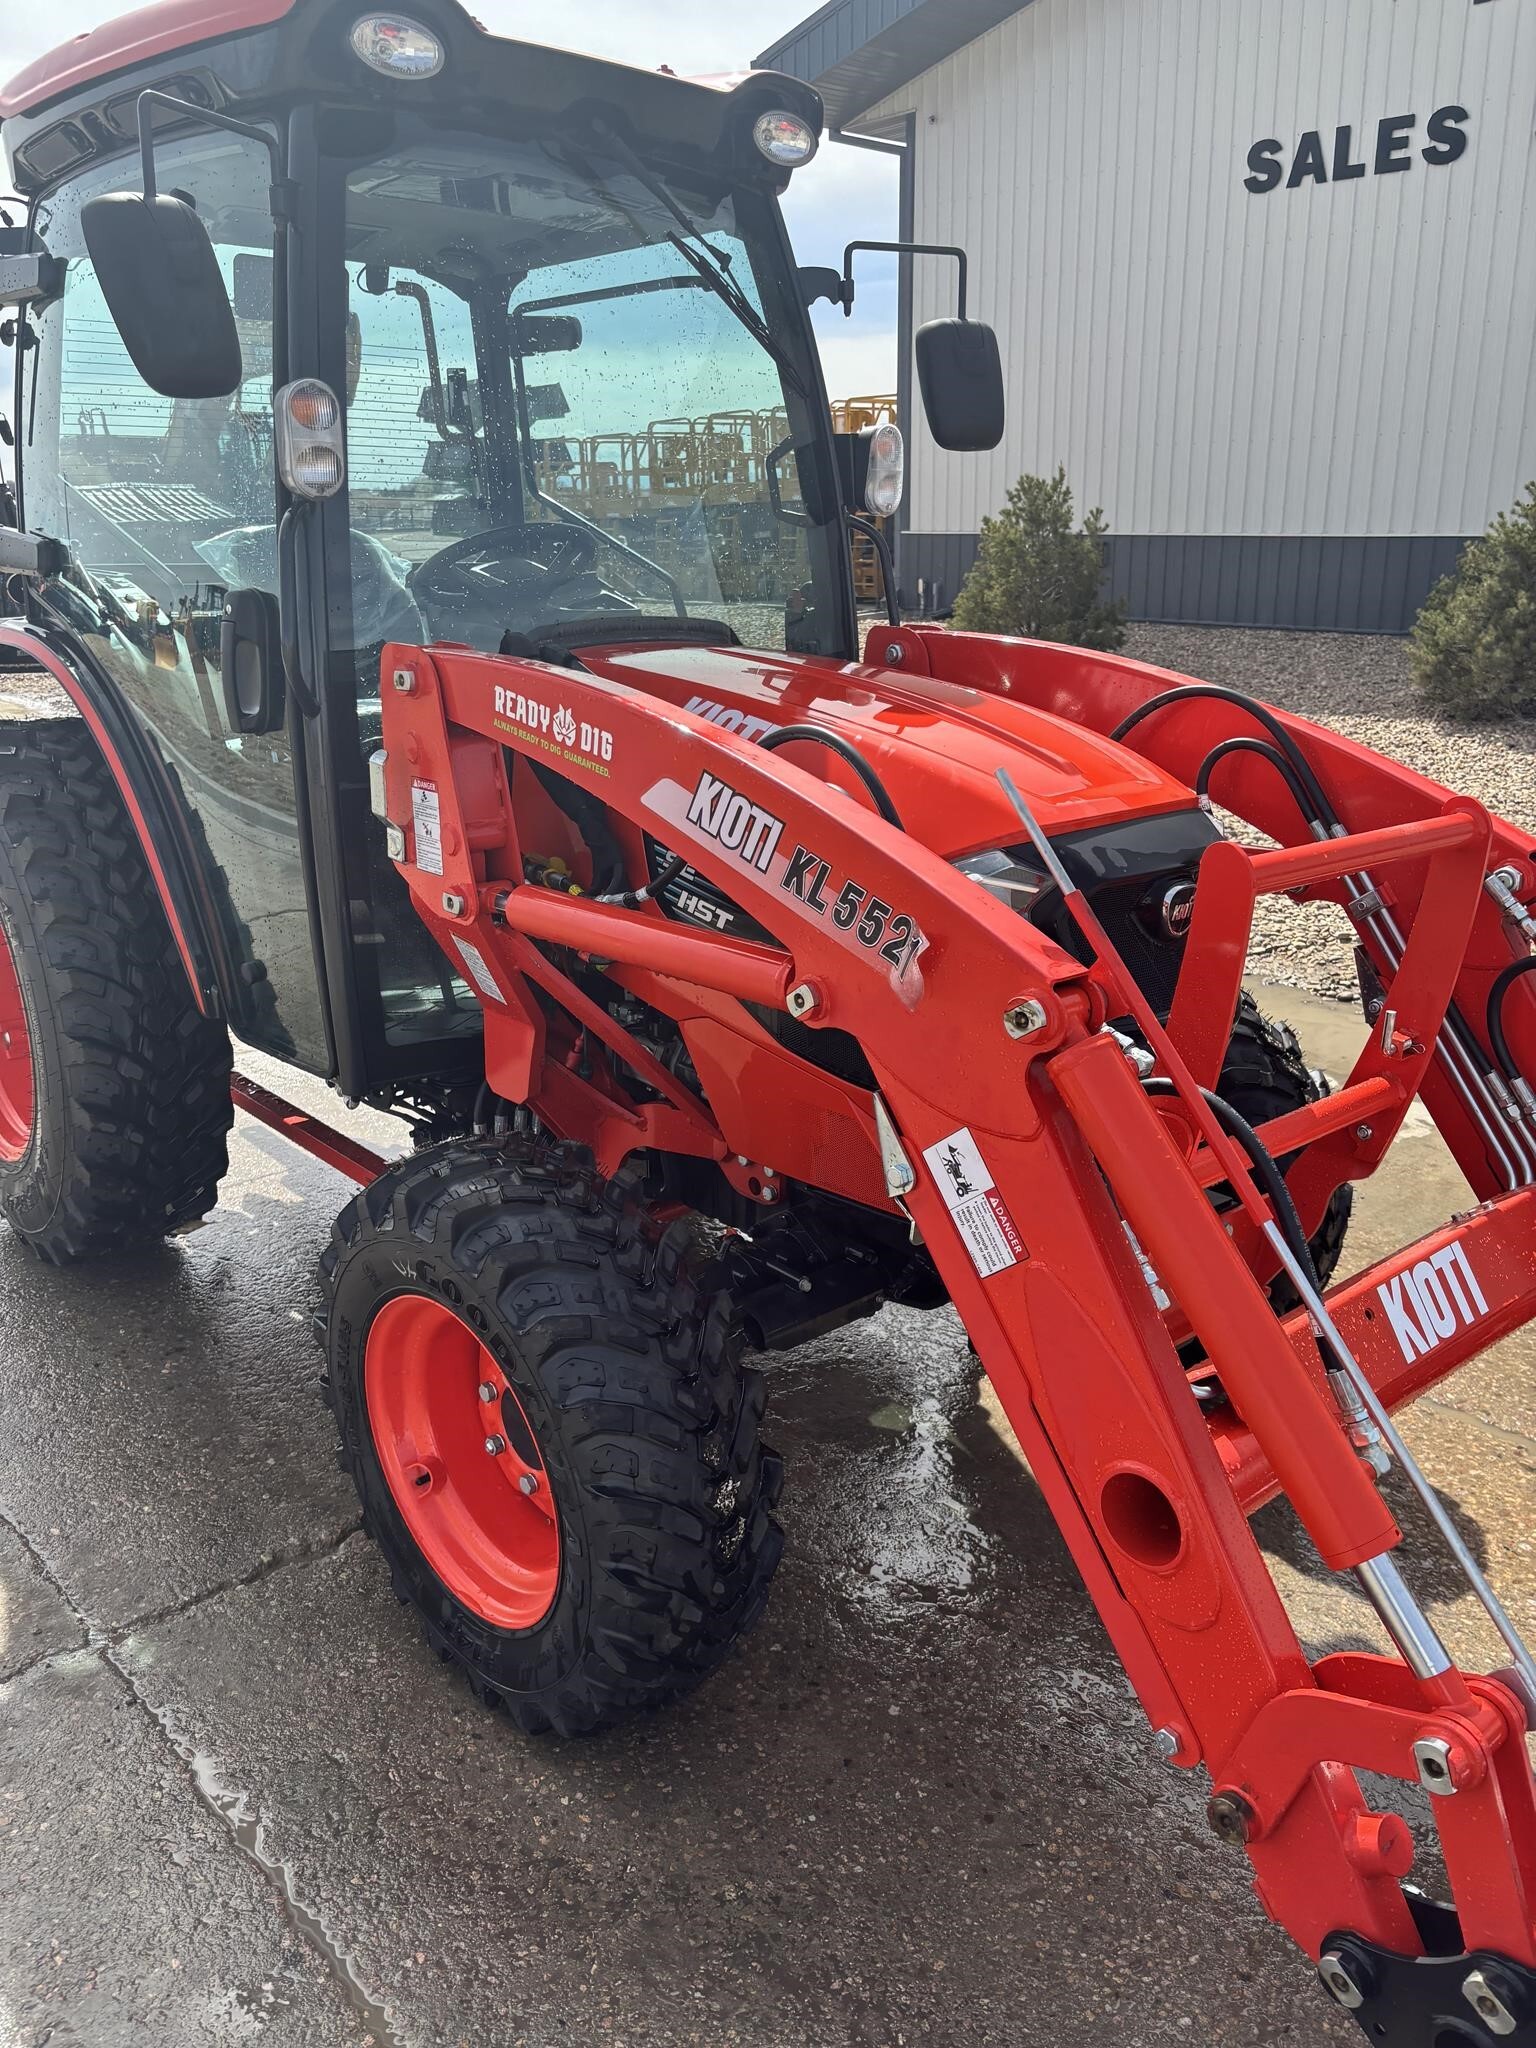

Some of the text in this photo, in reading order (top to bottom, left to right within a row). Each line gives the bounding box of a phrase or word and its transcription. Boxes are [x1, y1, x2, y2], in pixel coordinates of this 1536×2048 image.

[1243, 105, 1469, 194] SALES
[493, 718, 518, 736] ALWAYS
[518, 729, 539, 746] READY
[540, 738, 549, 750] TO
[550, 742, 562, 756] DIG
[494, 685, 613, 761] READY DIG
[417, 780, 436, 791] DANGER
[687, 770, 786, 874] KIOTI
[677, 890, 734, 930] HST
[995, 1207, 1022, 1254] DANGER
[1376, 1240, 1490, 1365] KIOTI
